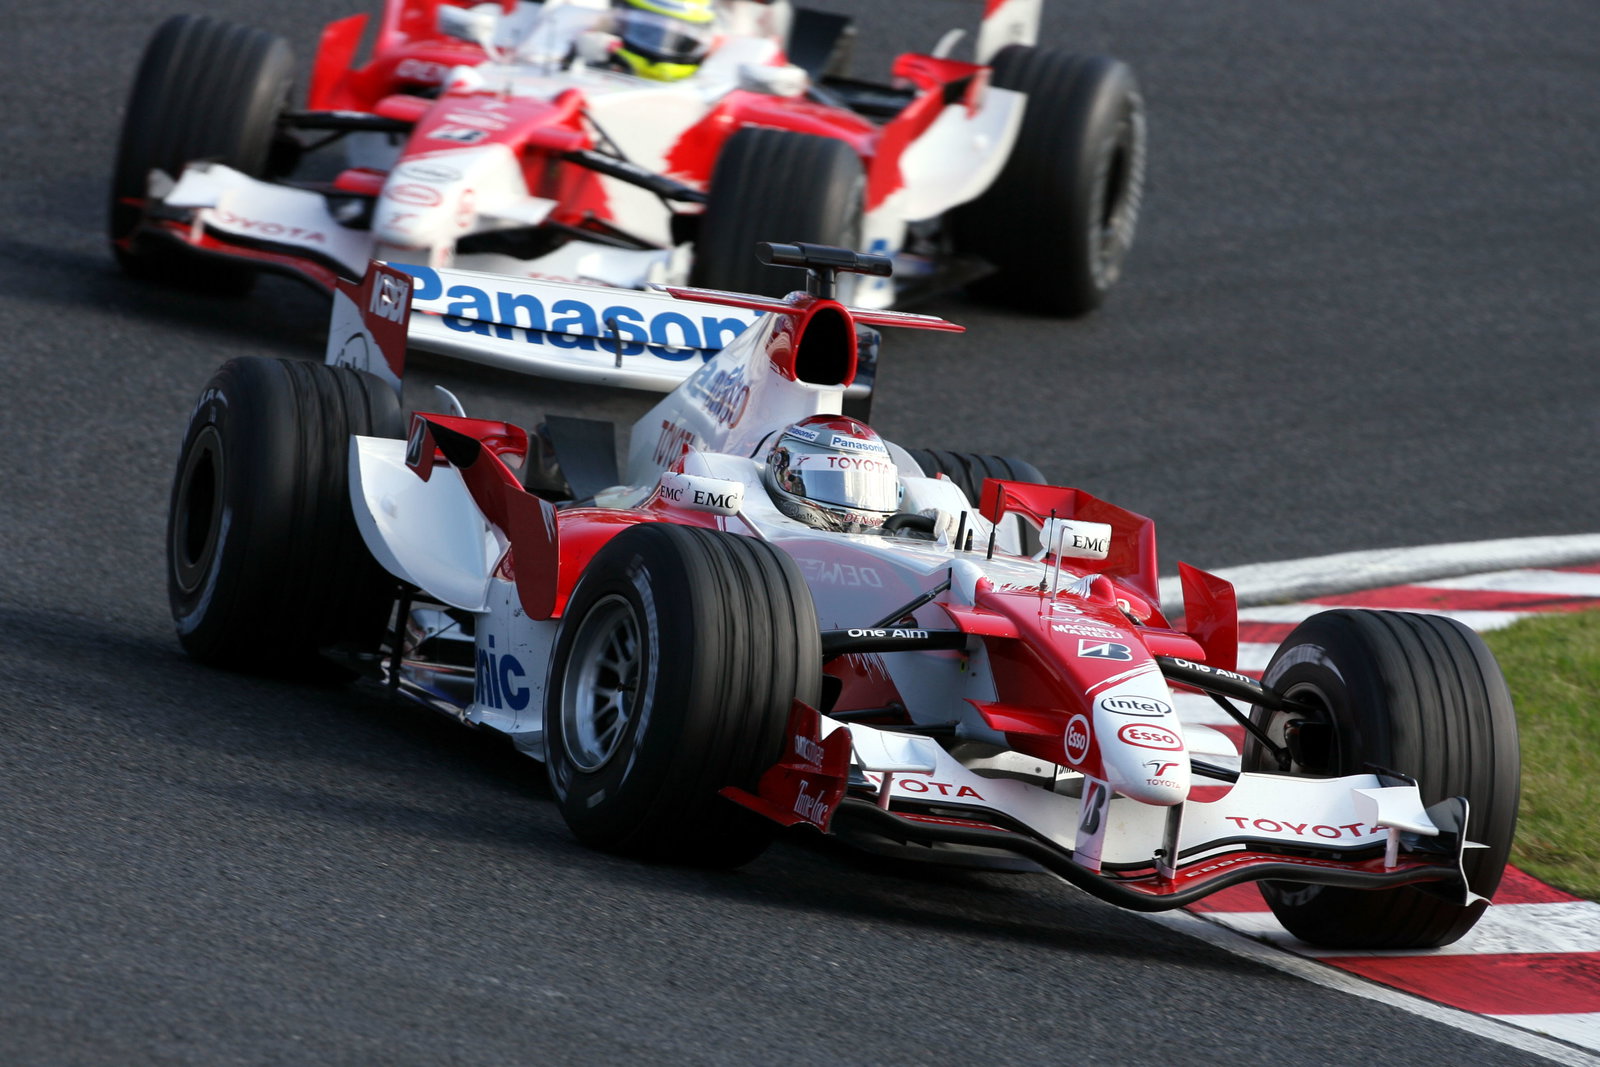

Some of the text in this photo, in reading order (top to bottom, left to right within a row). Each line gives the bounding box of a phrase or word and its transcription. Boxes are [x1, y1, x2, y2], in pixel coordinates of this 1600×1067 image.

[215, 211, 326, 243] OYOTA
[386, 261, 764, 363] Panason
[832, 437, 885, 453] Panasonic
[827, 456, 889, 473] TOYOTA
[848, 628, 886, 638] One
[1174, 657, 1211, 673] One
[1109, 697, 1162, 713] intel
[1128, 728, 1175, 744] Esso
[1146, 778, 1182, 789] TOYOTA
